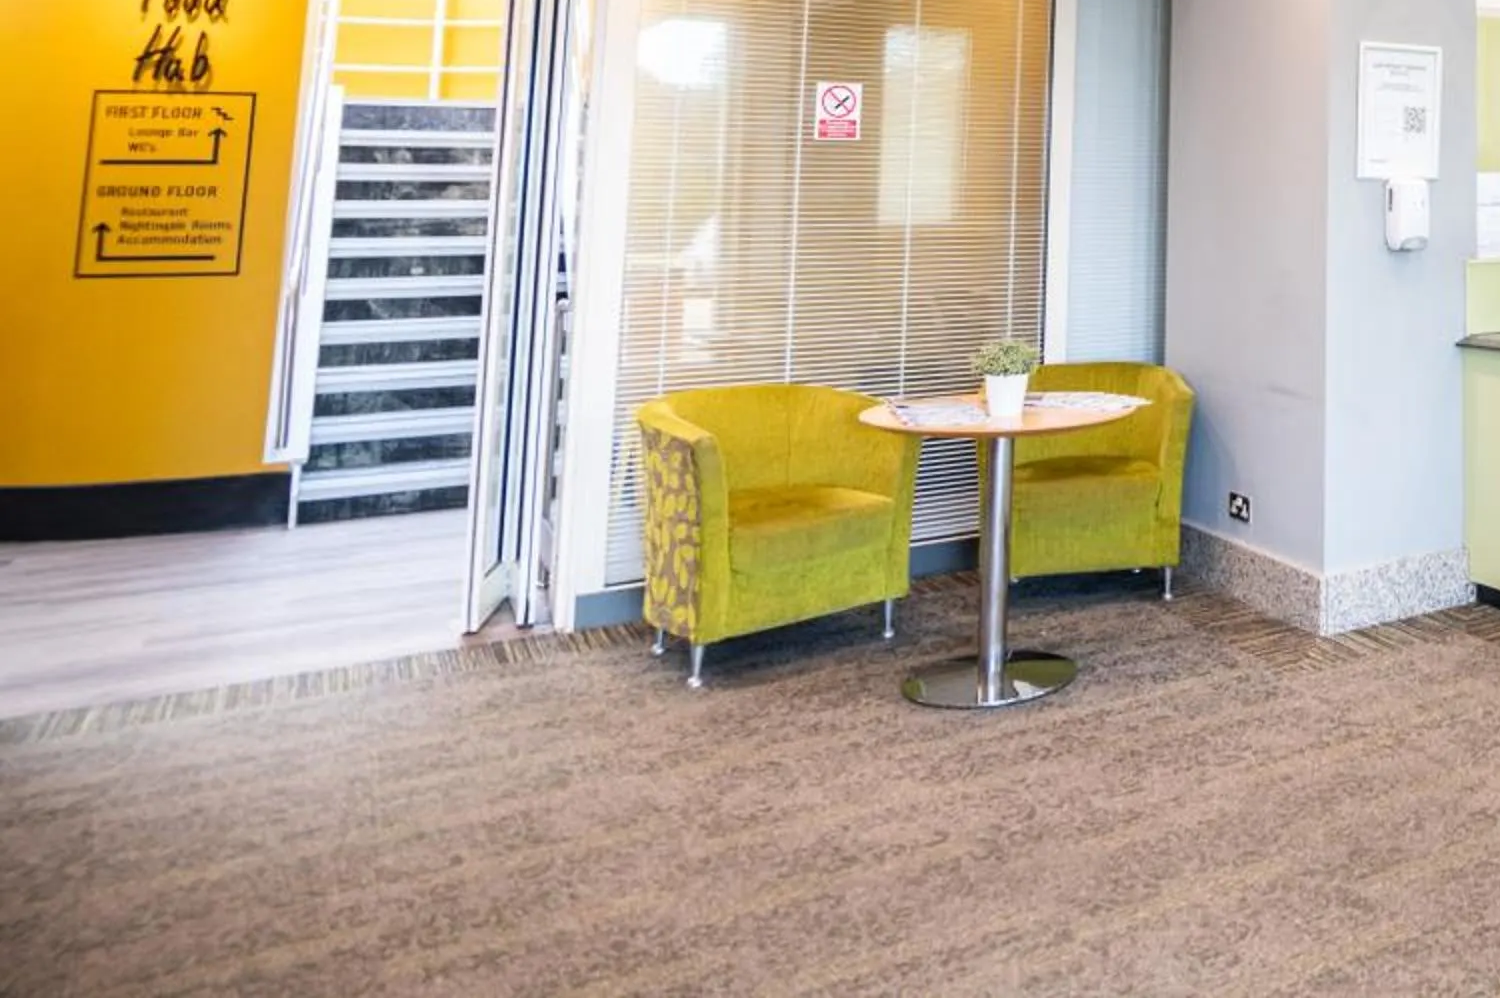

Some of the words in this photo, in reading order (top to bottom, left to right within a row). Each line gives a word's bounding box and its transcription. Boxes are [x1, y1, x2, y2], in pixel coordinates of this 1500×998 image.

[131, 23, 210, 84] Hub
[105, 105, 148, 120] FIRST
[151, 105, 203, 120] FLOOR
[96, 184, 162, 198] GROUND
[166, 185, 218, 198] FLOOR
[121, 206, 189, 217] Restaurant
[116, 233, 223, 246] Accommodation
